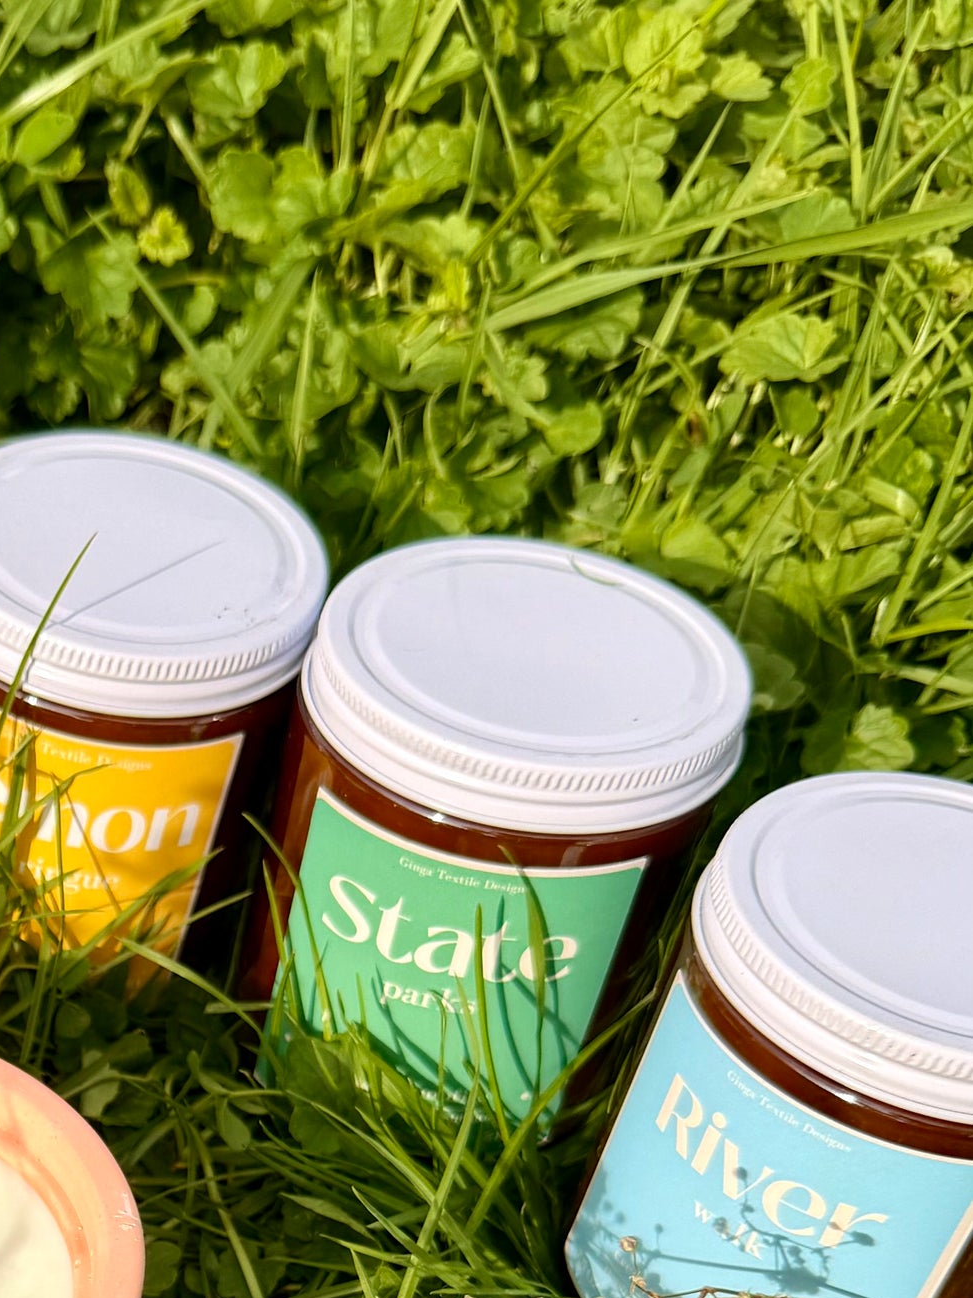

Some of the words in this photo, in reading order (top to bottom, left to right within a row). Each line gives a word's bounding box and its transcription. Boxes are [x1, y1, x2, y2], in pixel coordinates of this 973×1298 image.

[41, 741, 92, 765] Textile
[398, 855, 434, 878] Ginga
[436, 868, 481, 888] Textile
[483, 878, 527, 896] Design
[321, 874, 579, 984] State
[726, 1069, 757, 1101] Ginga
[758, 1093, 800, 1129] Textile
[802, 1121, 853, 1153] Designs
[655, 1072, 890, 1249] River
